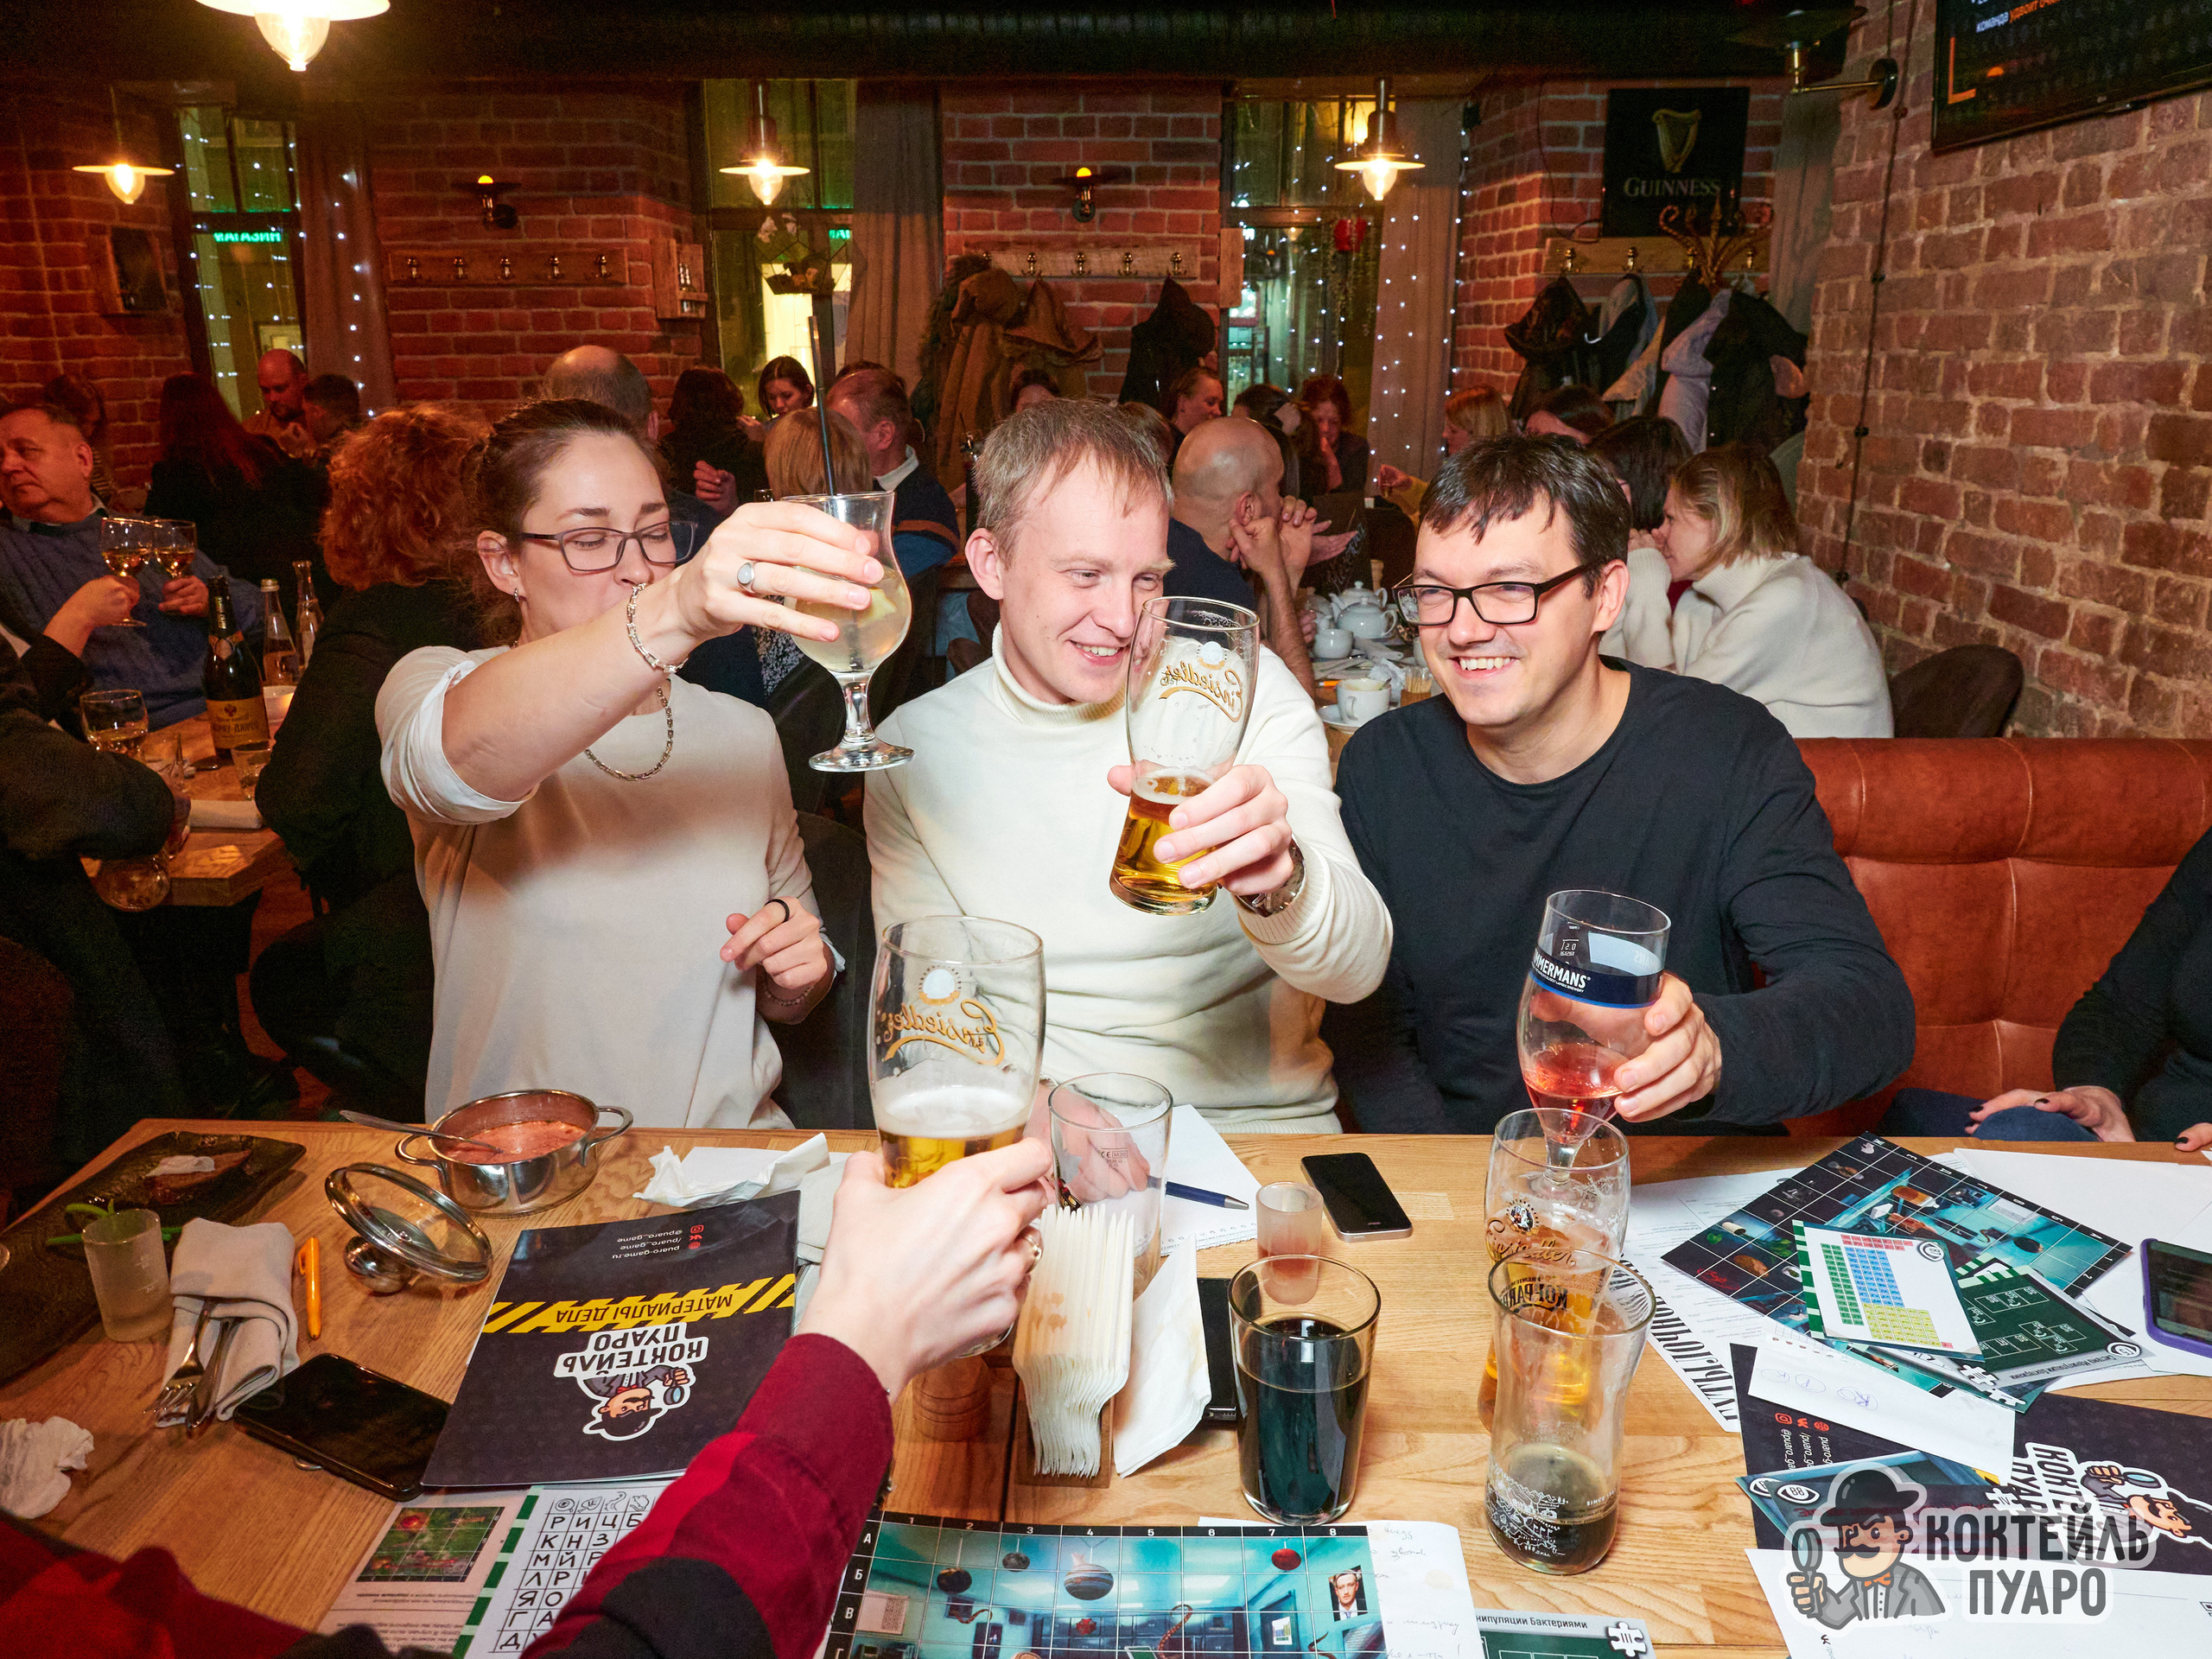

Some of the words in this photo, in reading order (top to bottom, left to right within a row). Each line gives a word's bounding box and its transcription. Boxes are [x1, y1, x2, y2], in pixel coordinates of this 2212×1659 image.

[1624, 176, 1721, 197] GUINNESS
[1533, 947, 1586, 989] MMERMANS
[616, 1229, 683, 1243] @puaro_game
[620, 1236, 682, 1251] /puaro_game
[612, 1244, 680, 1260] puaro-game.ru
[556, 1307, 610, 1323] ДЕЛА
[613, 1293, 734, 1321] МАТЕРИАЛЫ
[593, 1326, 678, 1351] ПУАРО
[562, 1339, 704, 1376] КОКТЕЙЛЬ
[1799, 1433, 1815, 1468] /puaro_ga
[1817, 1436, 1834, 1465] puaro-g
[550, 1516, 566, 1529] Р
[575, 1516, 591, 1529] И
[601, 1514, 619, 1529] Ц
[908, 1516, 915, 1525] 1
[965, 1522, 974, 1530] 2
[1026, 1526, 1034, 1535] 3
[1086, 1528, 1094, 1536] 4
[1207, 1528, 1216, 1536] 6
[1268, 1528, 1275, 1536] 7
[1329, 1528, 1337, 1536] 8
[540, 1534, 559, 1549] К
[567, 1534, 583, 1549] Н
[862, 1532, 872, 1545] А
[532, 1554, 551, 1567] М
[558, 1551, 576, 1567] Й
[553, 1571, 570, 1586] Р
[854, 1568, 863, 1580] Б
[518, 1590, 539, 1607] Я
[844, 1607, 854, 1621] В
[1476, 1615, 1529, 1626] нипуляции
[1529, 1617, 1588, 1630] Бактериями
